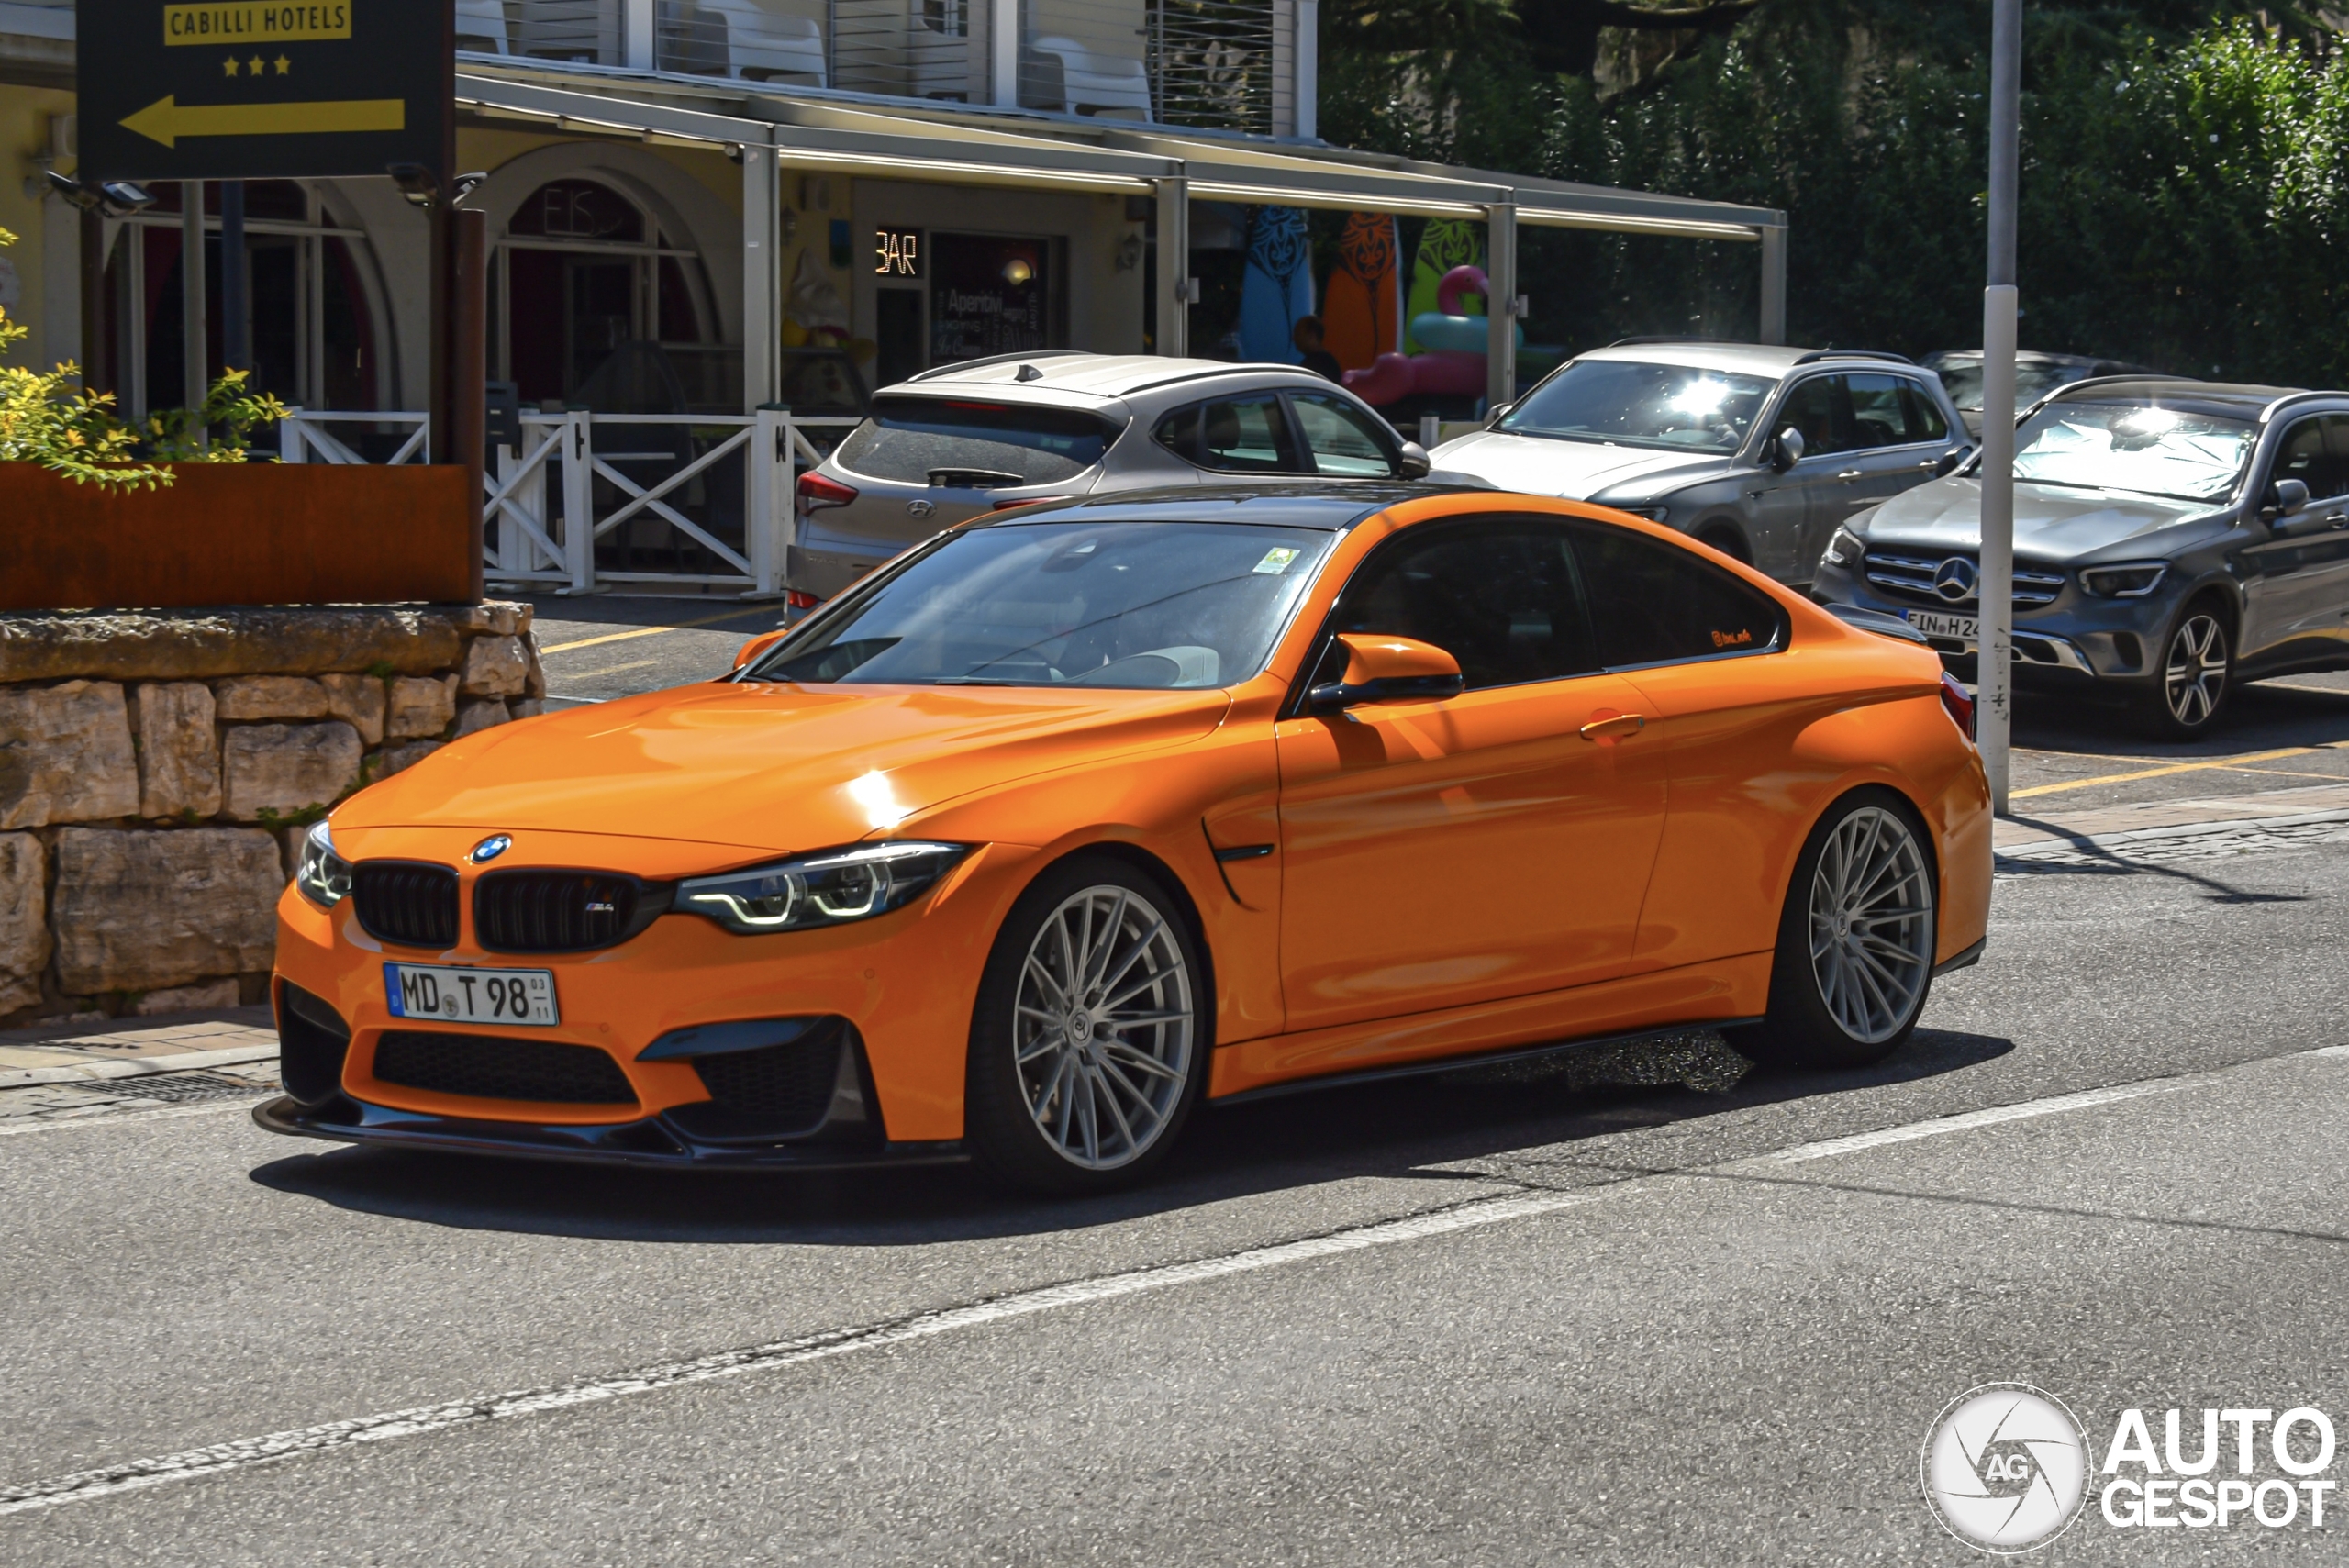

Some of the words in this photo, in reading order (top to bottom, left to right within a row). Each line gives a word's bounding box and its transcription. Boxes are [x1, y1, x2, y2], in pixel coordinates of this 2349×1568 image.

[171, 10, 252, 36] CABILLI
[264, 5, 345, 31] HOTELS
[875, 231, 916, 275] BAR
[948, 288, 1003, 318] Aperitivi
[401, 971, 440, 1013] MD
[458, 975, 477, 1016] T
[487, 977, 529, 1018] 98
